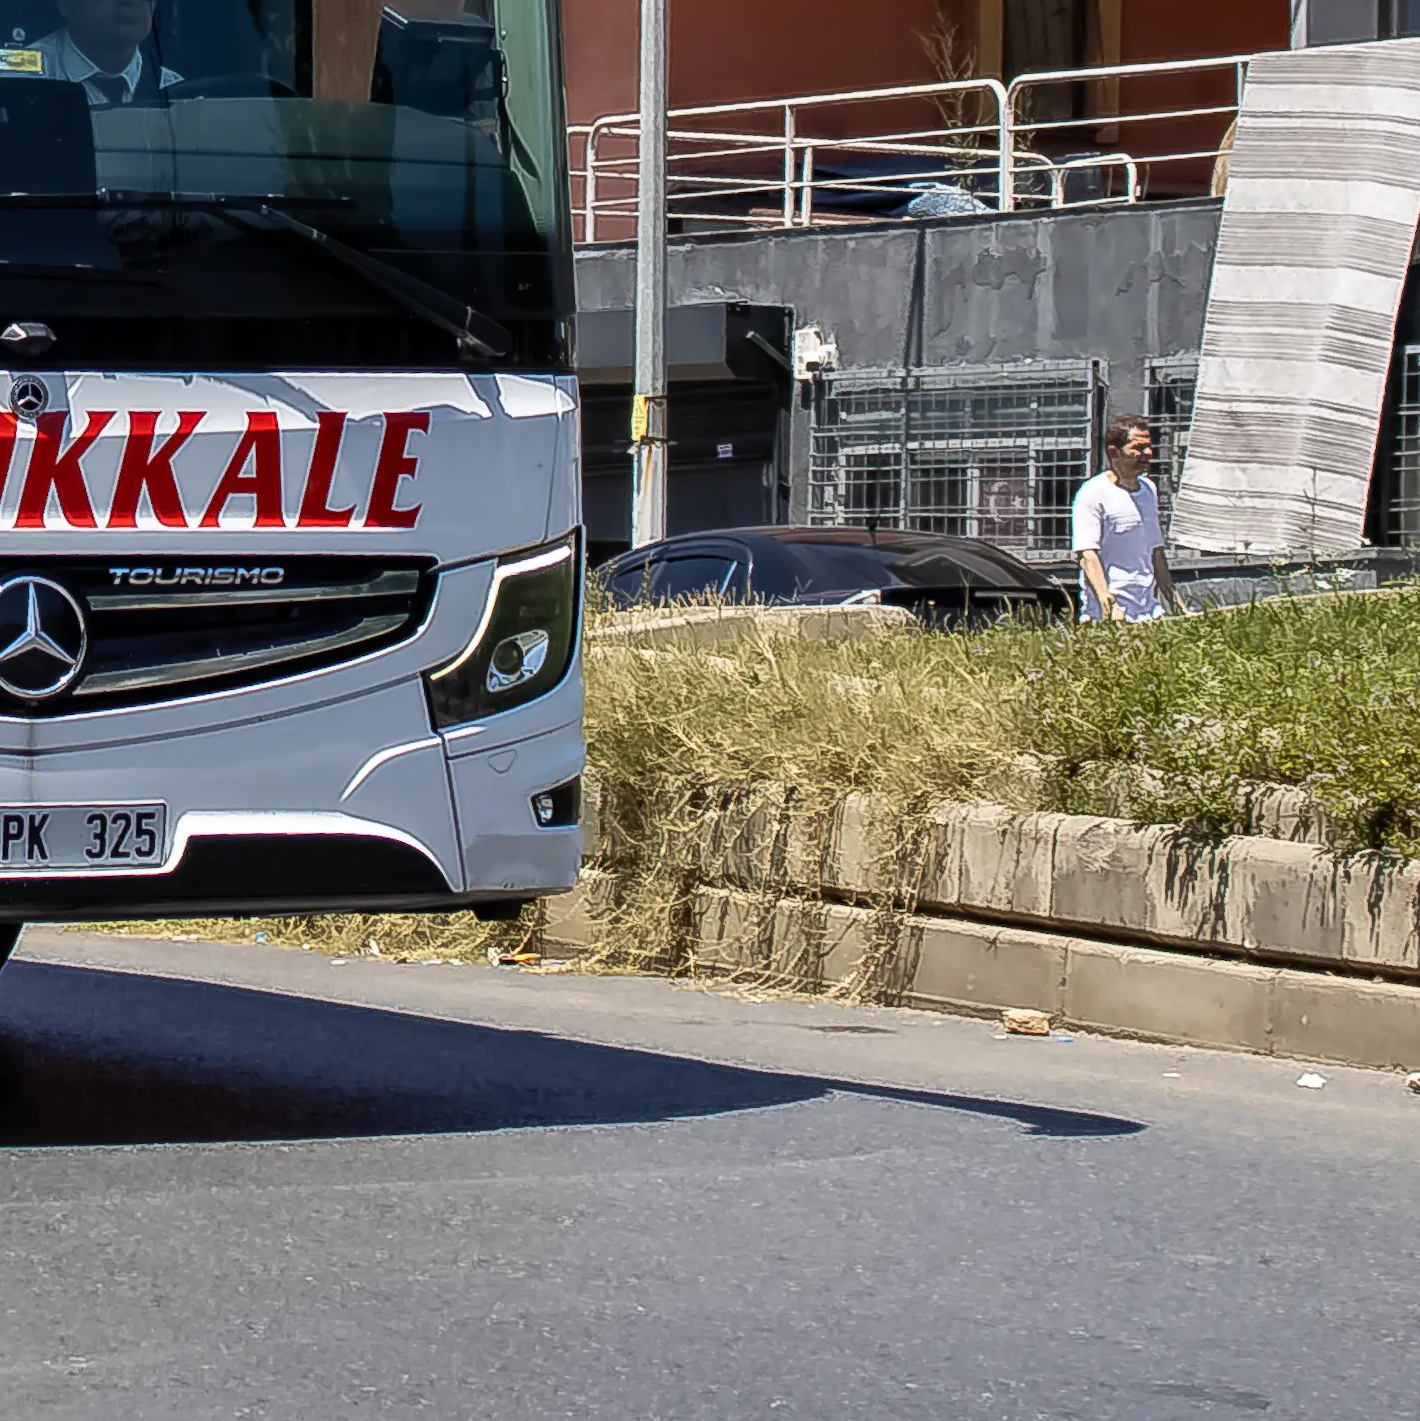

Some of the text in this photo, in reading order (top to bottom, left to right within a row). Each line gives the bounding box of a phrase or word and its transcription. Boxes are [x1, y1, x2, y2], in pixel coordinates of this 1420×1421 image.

[108, 566, 285, 585] TOURISMO
[0, 813, 51, 861] PK
[84, 811, 157, 860] 325
